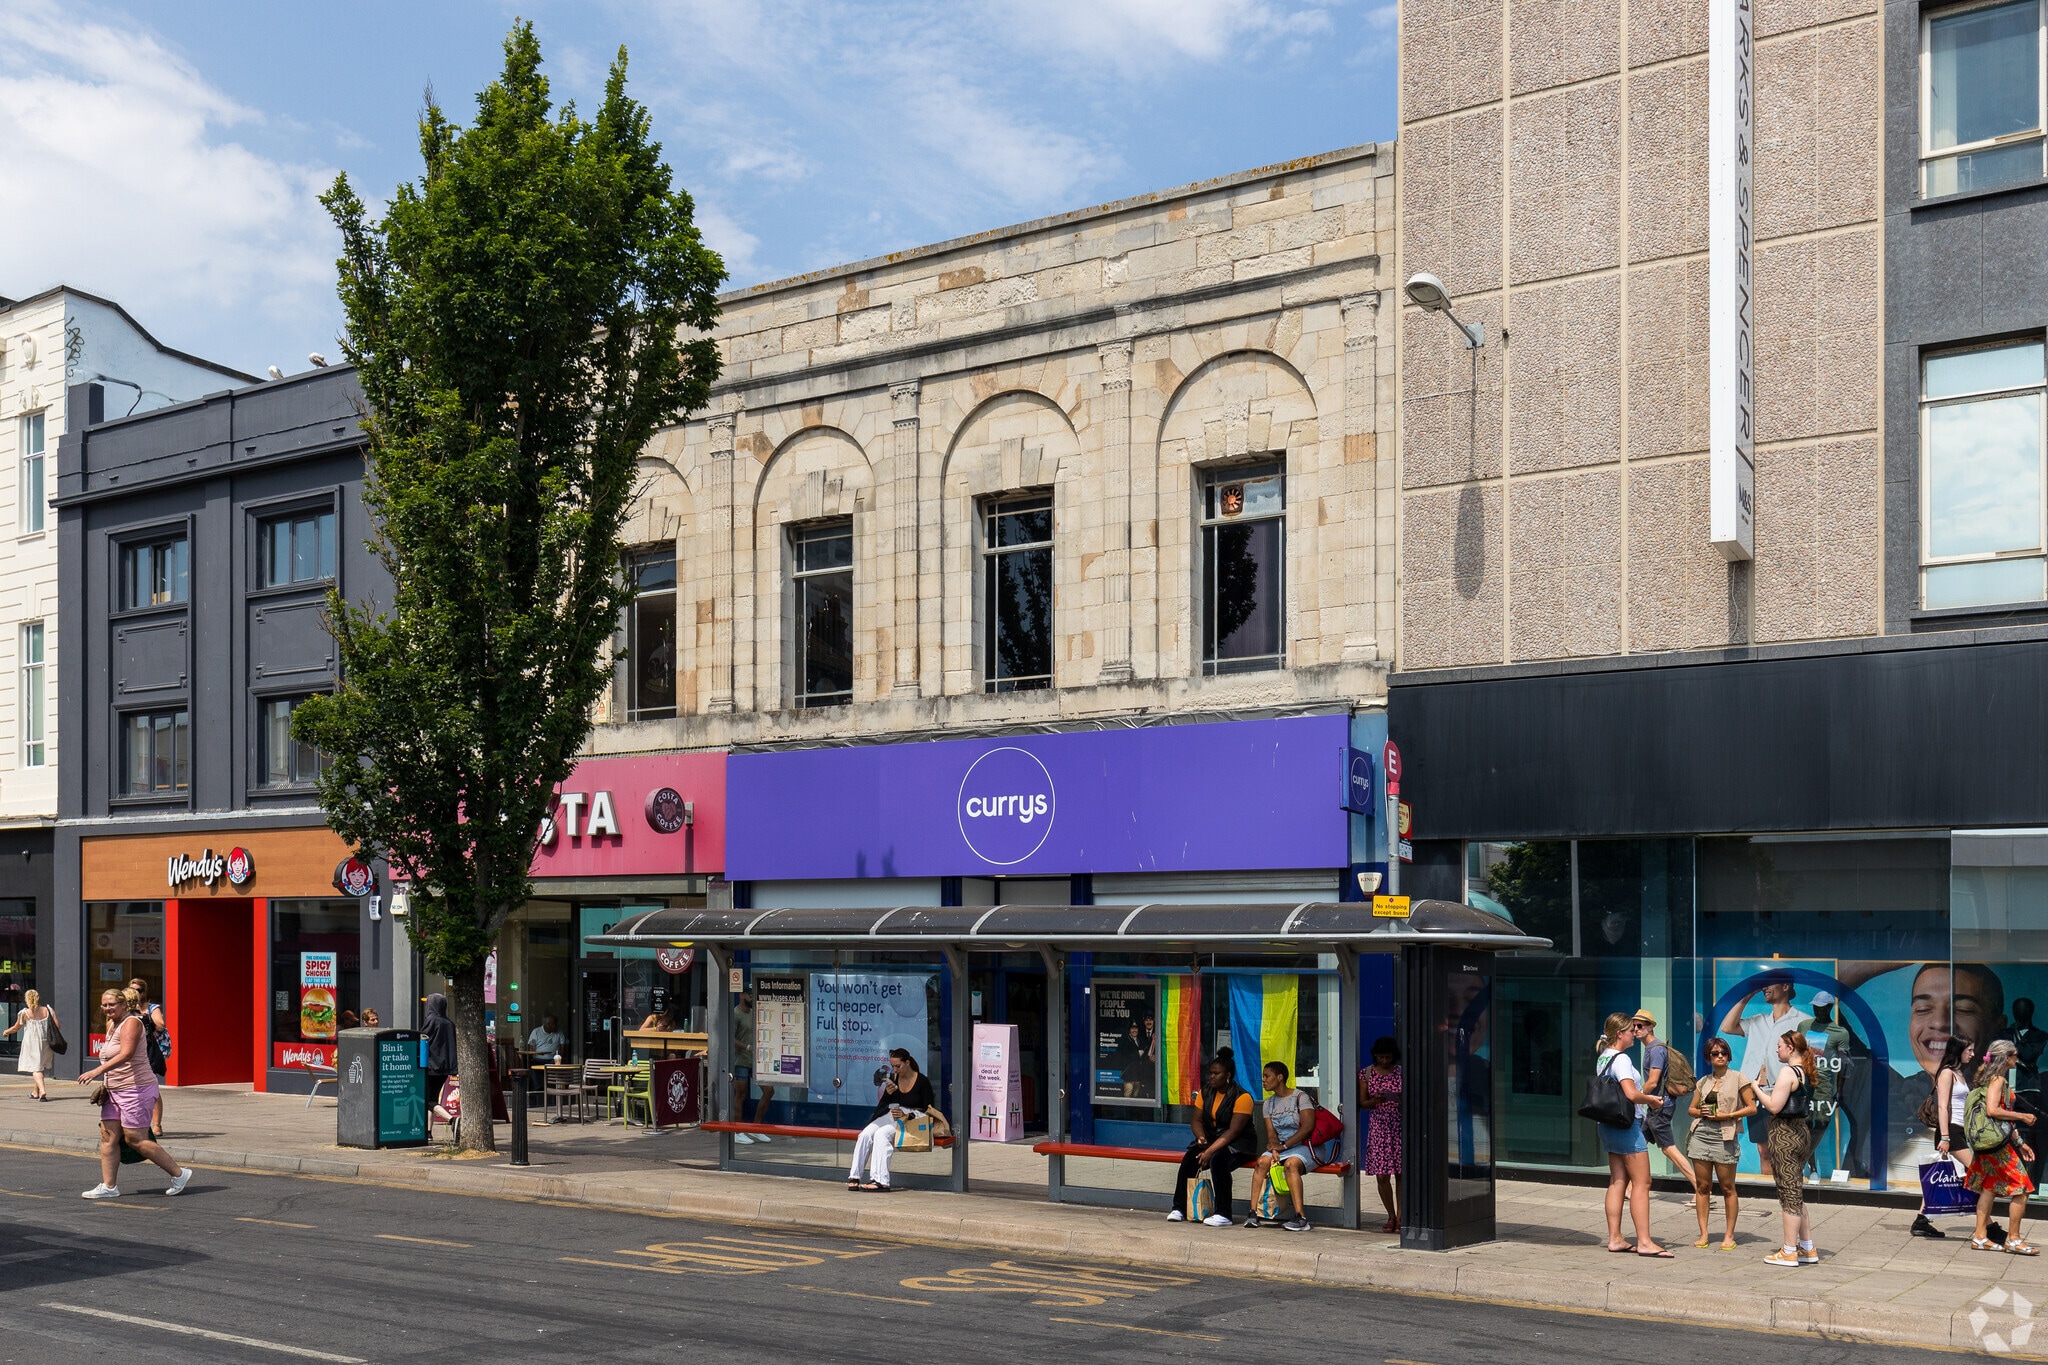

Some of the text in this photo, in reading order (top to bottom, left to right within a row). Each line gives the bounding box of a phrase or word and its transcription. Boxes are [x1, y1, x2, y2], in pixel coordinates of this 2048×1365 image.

[1738, 133, 1749, 167] &
[1738, 177, 1751, 440] SPENCER
[1738, 482, 1752, 516] M&S
[1388, 749, 1398, 775] E
[1352, 773, 1370, 790] currys
[657, 792, 680, 805] COSTA
[966, 793, 1048, 824] currys
[656, 813, 682, 829] COFFEE
[168, 848, 223, 887] Wendy's
[305, 960, 332, 971] SPICY
[659, 951, 690, 969] COFFEE
[760, 980, 802, 990] Bus Information
[817, 979, 903, 999] You won't get
[1100, 990, 1146, 1000] WE'RE HIRING
[816, 998, 884, 1016] it cheaper.
[1099, 1000, 1126, 1009] PEOPLE
[1099, 1008, 1130, 1018] LIKE YOU
[816, 1016, 873, 1035] Full stop.
[282, 1046, 312, 1066] Wendy's
[382, 1043, 403, 1052] Bin it
[392, 1053, 410, 1061] take
[382, 1062, 412, 1071] it home
